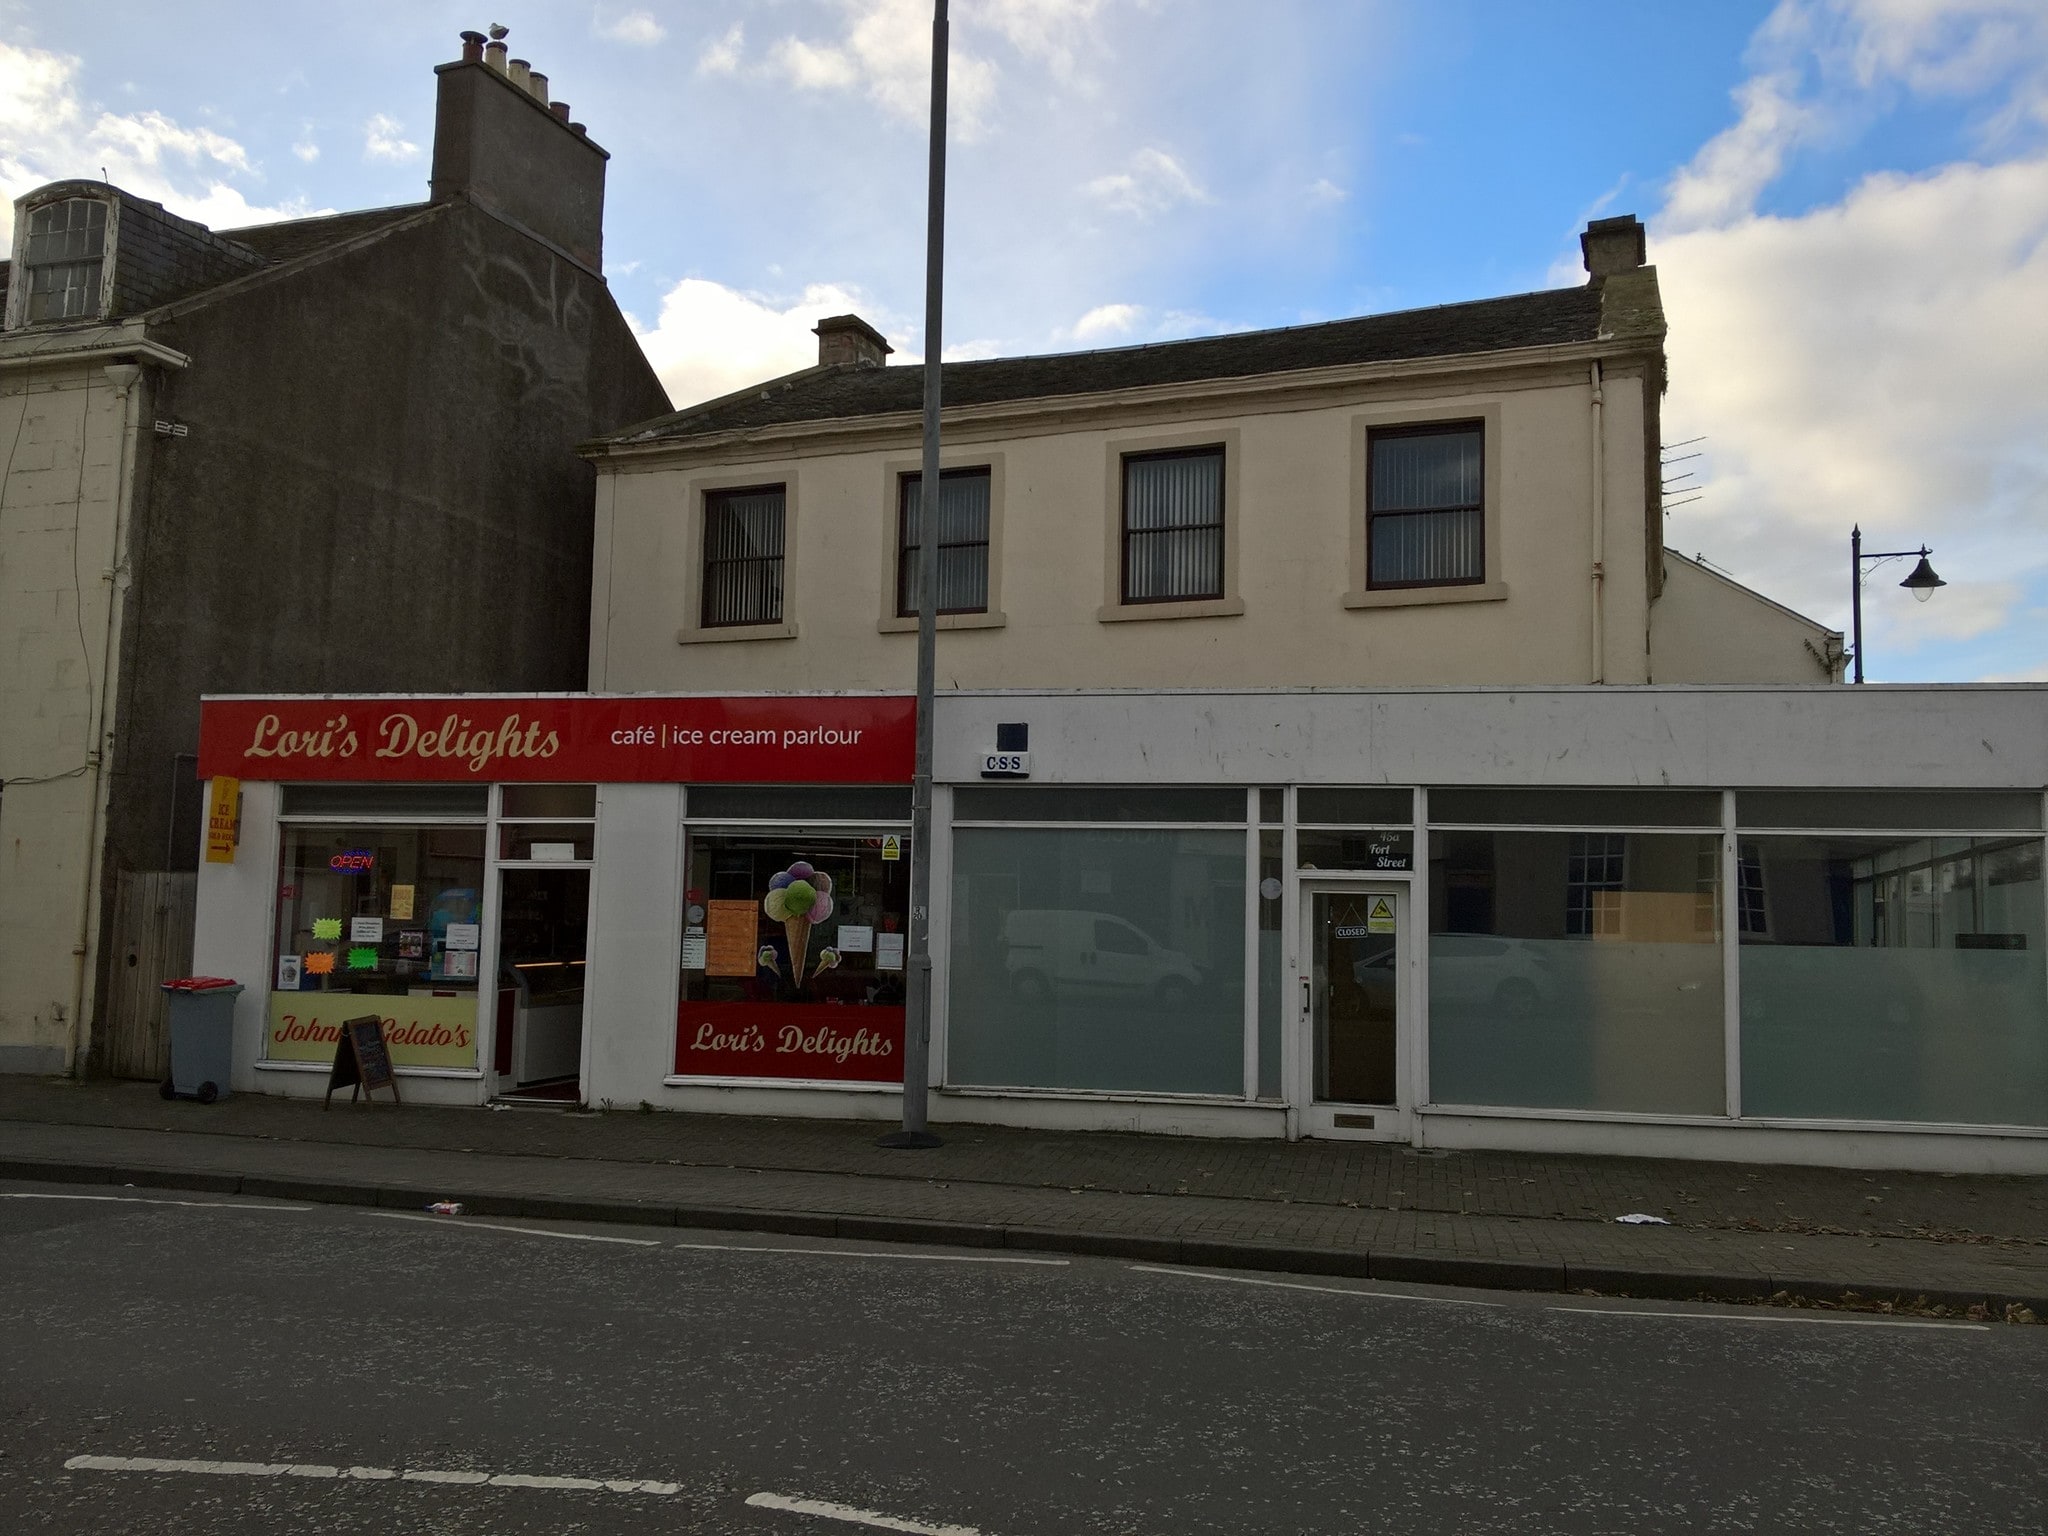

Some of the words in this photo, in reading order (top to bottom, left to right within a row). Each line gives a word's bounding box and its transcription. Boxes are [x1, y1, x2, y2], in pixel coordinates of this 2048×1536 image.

[244, 714, 358, 757] Lori's
[376, 713, 560, 772] Delights
[611, 725, 655, 745] café
[673, 725, 703, 745] ice
[709, 729, 776, 745] cream
[783, 725, 862, 749] parlour
[218, 804, 229, 816] ICE
[210, 818, 235, 830] CREAM
[1370, 844, 1390, 854] Fort
[330, 855, 375, 869] OPEN
[1376, 856, 1406, 867] Street
[1337, 928, 1366, 937] CLOSED
[690, 1023, 765, 1052] Lori's
[775, 1024, 893, 1064] Delights
